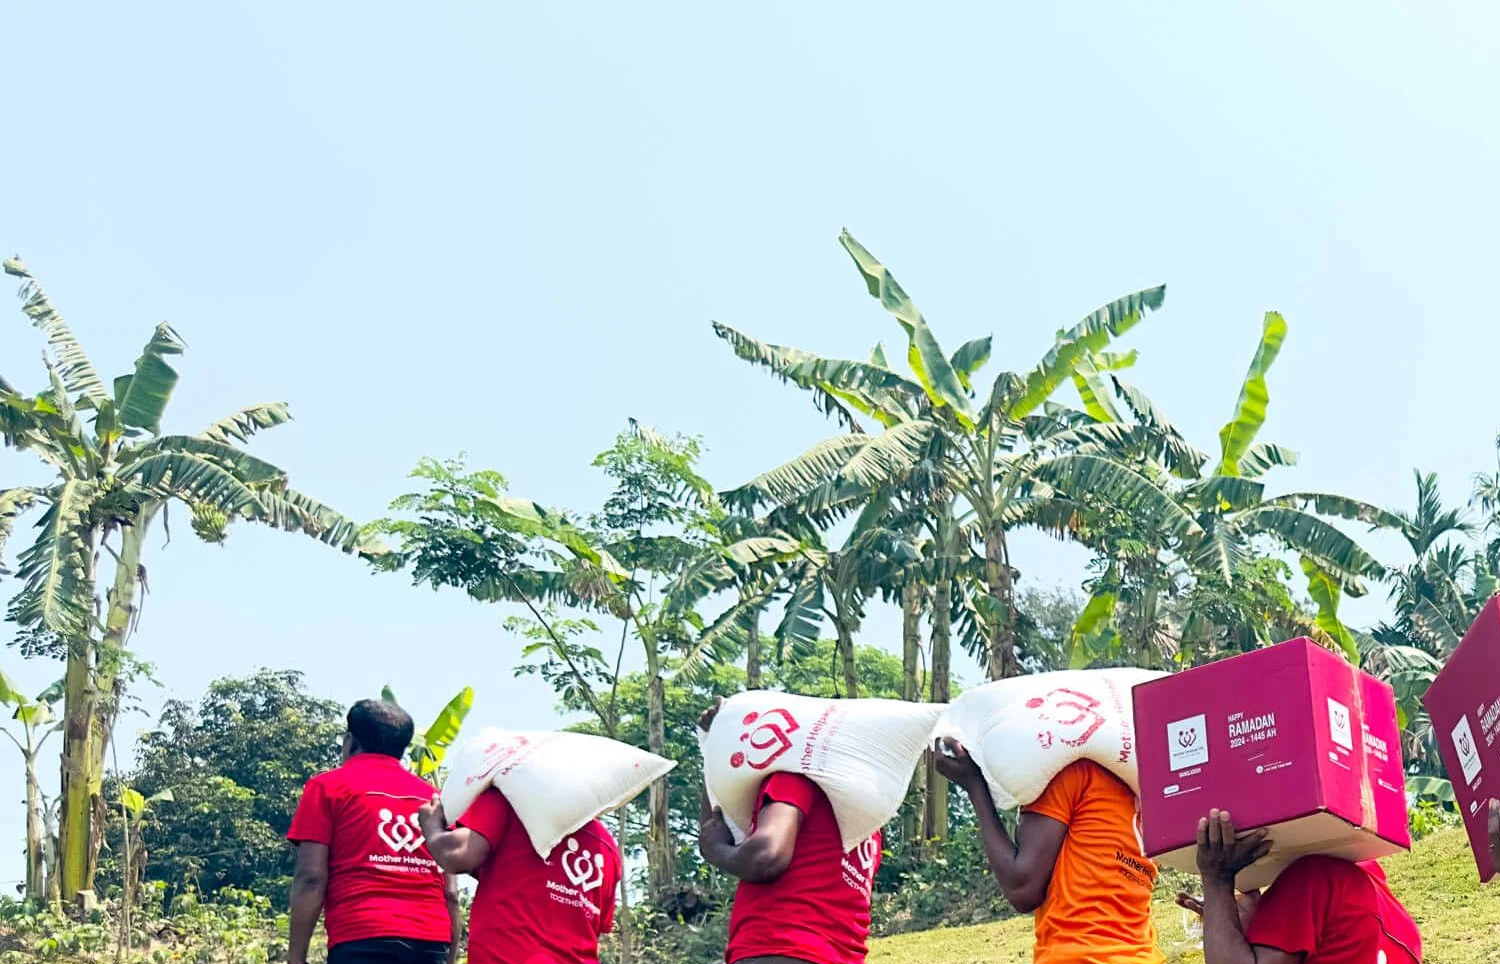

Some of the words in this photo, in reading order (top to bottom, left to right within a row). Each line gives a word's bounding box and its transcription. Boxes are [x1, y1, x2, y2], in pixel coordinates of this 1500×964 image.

[1229, 712, 1275, 738] RAMADAN
[1251, 731, 1265, 743] 1445
[1267, 727, 1277, 738] AH
[369, 854, 401, 863] Mother
[546, 879, 579, 896] Mother
[550, 892, 584, 908] TOGETHER
